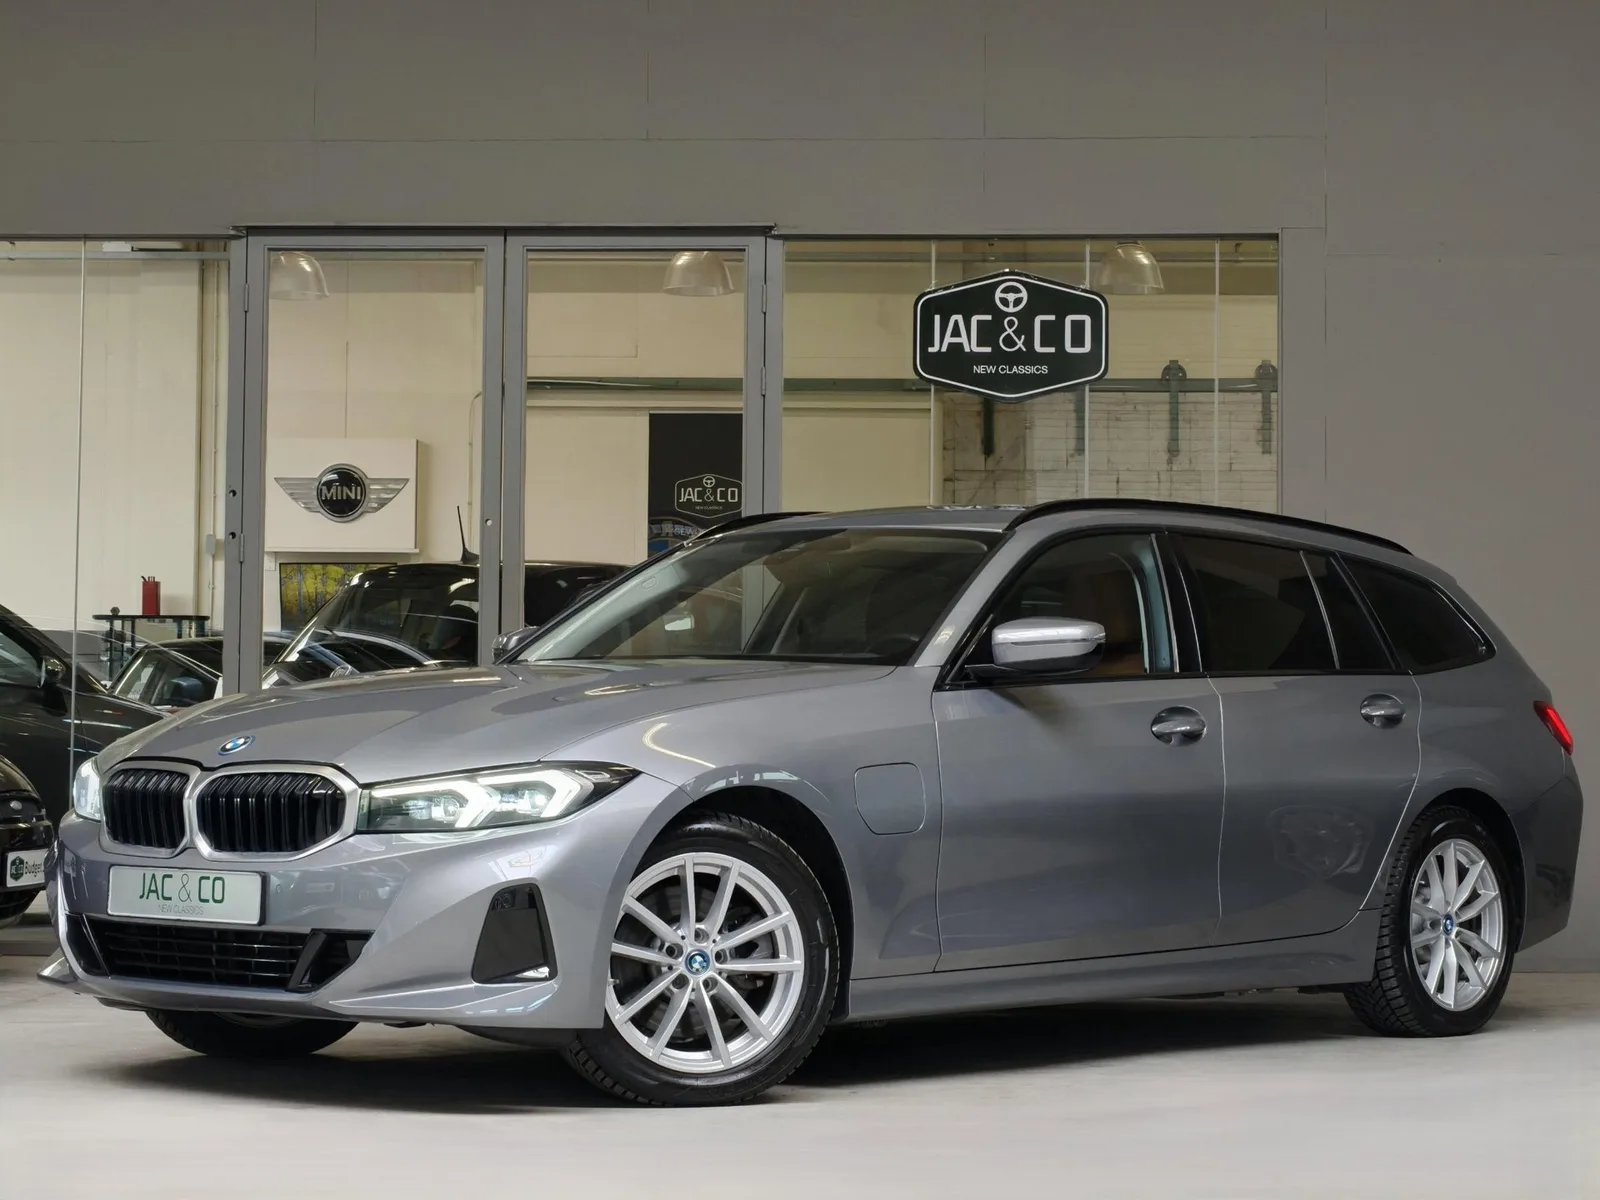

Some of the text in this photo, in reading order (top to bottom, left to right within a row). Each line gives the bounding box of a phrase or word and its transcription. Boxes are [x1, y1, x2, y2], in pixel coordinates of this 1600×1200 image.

[973, 365, 1048, 375] NEW CLASSICS
[321, 485, 361, 500] MINI
[139, 872, 173, 901] JAC
[198, 876, 225, 904] CO
[158, 904, 172, 913] NEW
